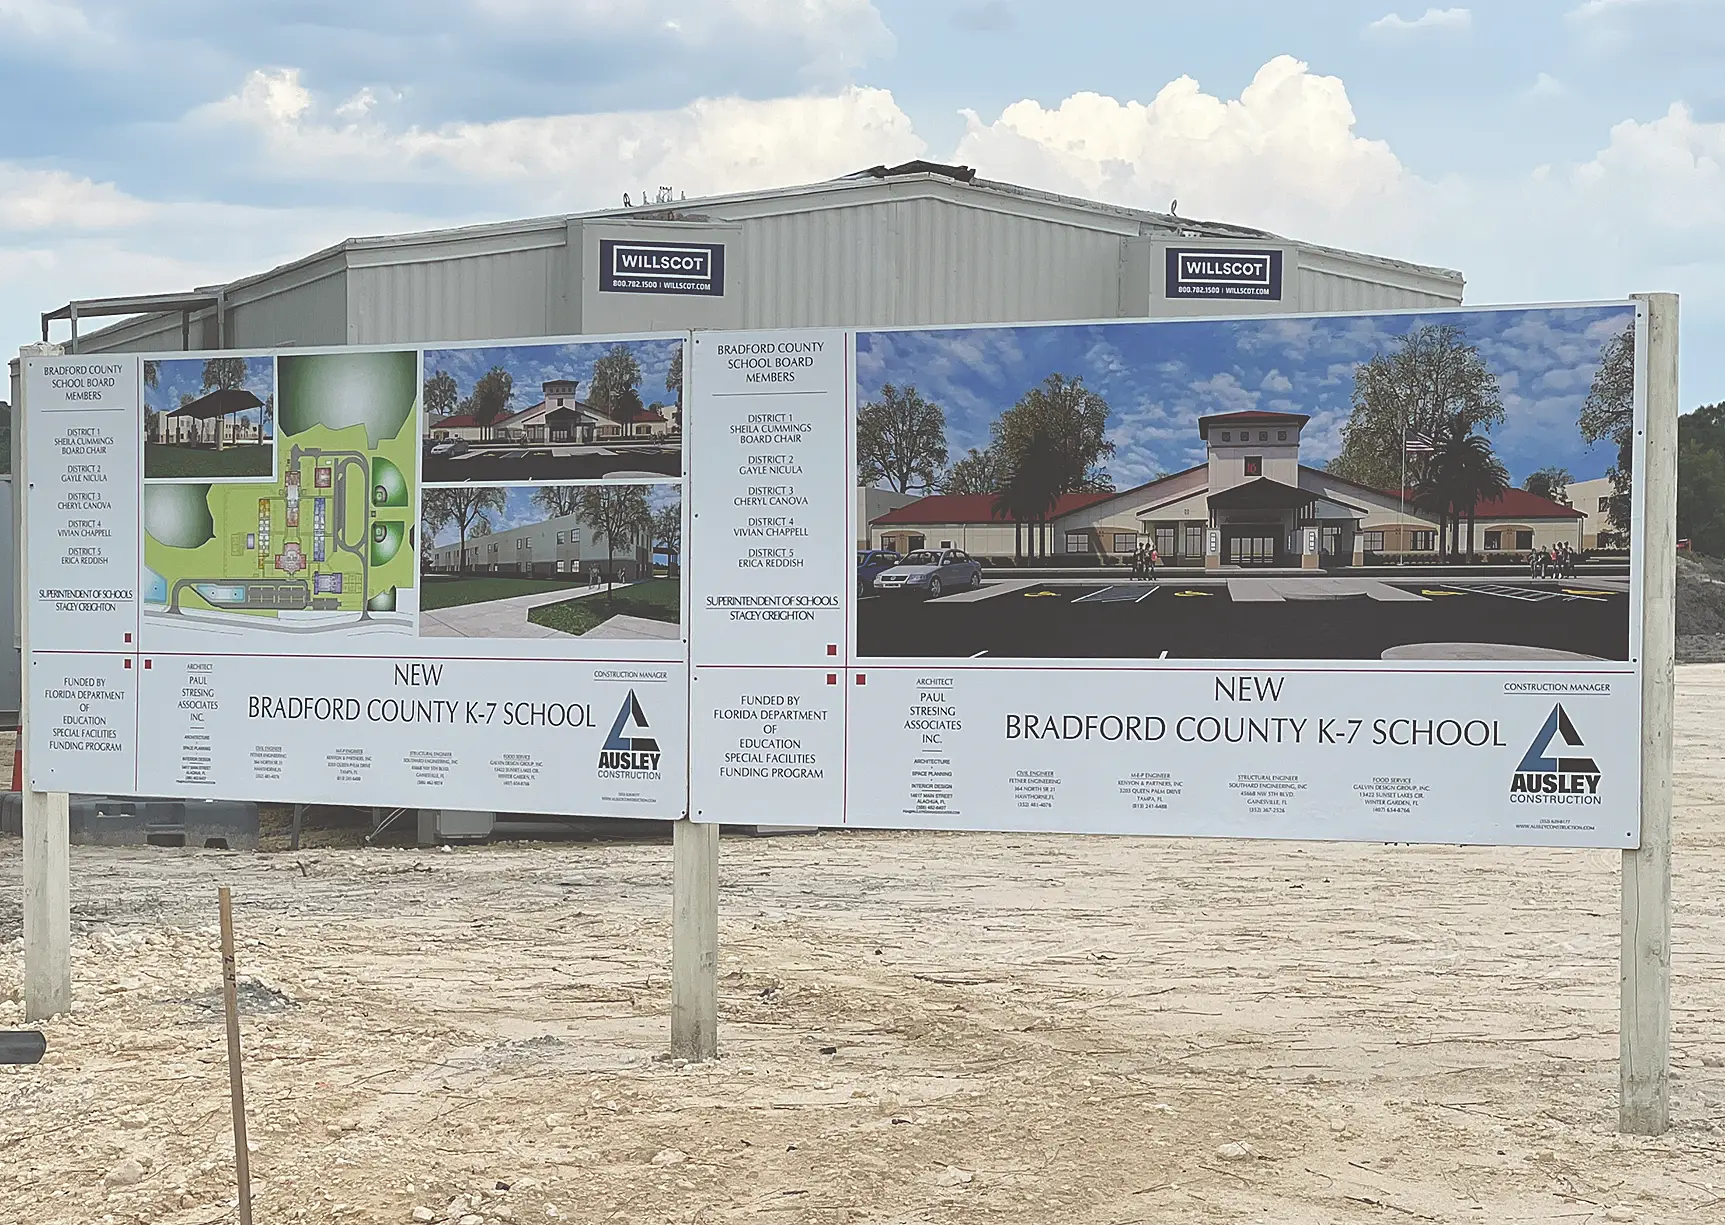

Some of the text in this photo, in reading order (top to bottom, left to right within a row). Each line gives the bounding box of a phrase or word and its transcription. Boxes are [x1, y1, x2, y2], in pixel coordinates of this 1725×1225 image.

[622, 255, 703, 270] WILLSCOT
[1187, 262, 1262, 275] WILLSCOT
[613, 280, 710, 290] 800.782.1500 WILLSCOT.COM
[718, 342, 824, 354] BRADFORD COUNTY
[728, 357, 813, 369] SCHOOL BOARD
[44, 365, 122, 375] BRADFORD COUNTY
[746, 372, 795, 382] MEMBERS
[52, 378, 115, 388] SCHOOL BOARD
[66, 391, 101, 400] MEMBERS
[748, 414, 792, 422] DISTRICT 1
[67, 428, 95, 436] DISTRICT
[730, 424, 811, 434] SHEILA CUMMINGS
[77, 437, 113, 445] CUMMINGS
[740, 434, 801, 444] BOARD CHAIR
[748, 456, 794, 464] DISTRICT 2
[68, 465, 95, 473] DISTRICT
[740, 466, 802, 475] GAYLE NICULA
[748, 487, 794, 495] DISTRICT 3
[734, 497, 808, 506] CHERYL CANOVA
[68, 520, 96, 528] DISTRICT
[748, 518, 794, 526] DISTRICT 4
[734, 528, 808, 536] VIVIAN CHAPPELL
[748, 549, 794, 558] DISTRICT 5
[738, 559, 804, 568] ERICA REDDISH
[39, 590, 132, 598] SUPERINTENDENT OF SCHOOLS
[707, 596, 838, 606] SUPERINTENDENT OF SCHOOLS
[56, 603, 116, 611] STACEY CREIGHTON
[730, 611, 814, 620] STACEY CREIGHTON
[187, 664, 213, 672] ARCHITECT
[395, 662, 443, 687] NEW
[64, 677, 106, 687] FUNDED BY
[189, 676, 207, 685] PAUL
[1215, 677, 1284, 701] NEW
[1504, 683, 1568, 691] CONSTRUCTION
[45, 690, 125, 700] FLORIDA DEPARTMENT
[182, 688, 214, 697] STRESING
[740, 696, 800, 706] FUNDED BY
[921, 693, 946, 702] PAUL
[80, 703, 89, 712] OF
[178, 700, 218, 709] ASSOCIATES
[249, 696, 596, 727] BRADFORD COUNTY K-7 SCHOOL
[714, 709, 828, 722] FLORIDA DEPARTMENT
[910, 706, 955, 716] STRESING
[63, 716, 106, 725] EDUCATION
[190, 713, 204, 721] INC.
[763, 725, 778, 734] OF
[904, 720, 961, 730] ASSOCIATES
[53, 728, 116, 739] SPECIAL FACILITIES
[1007, 715, 1506, 746] BRADFORD COUNTY K-7 SCHOOL
[740, 737, 800, 749] EDUCATION
[923, 734, 942, 743] INC.
[50, 741, 121, 751] FUNDING PROGRAM
[598, 752, 660, 770] AUSLEY
[725, 752, 815, 764] SPECIAL FACILITIES
[598, 770, 660, 779] CONSTRUCTION
[720, 765, 823, 780] FUNDING PROGRAM
[1510, 774, 1601, 793] AUSLEY
[1510, 794, 1601, 804] CONSTRUCTION
